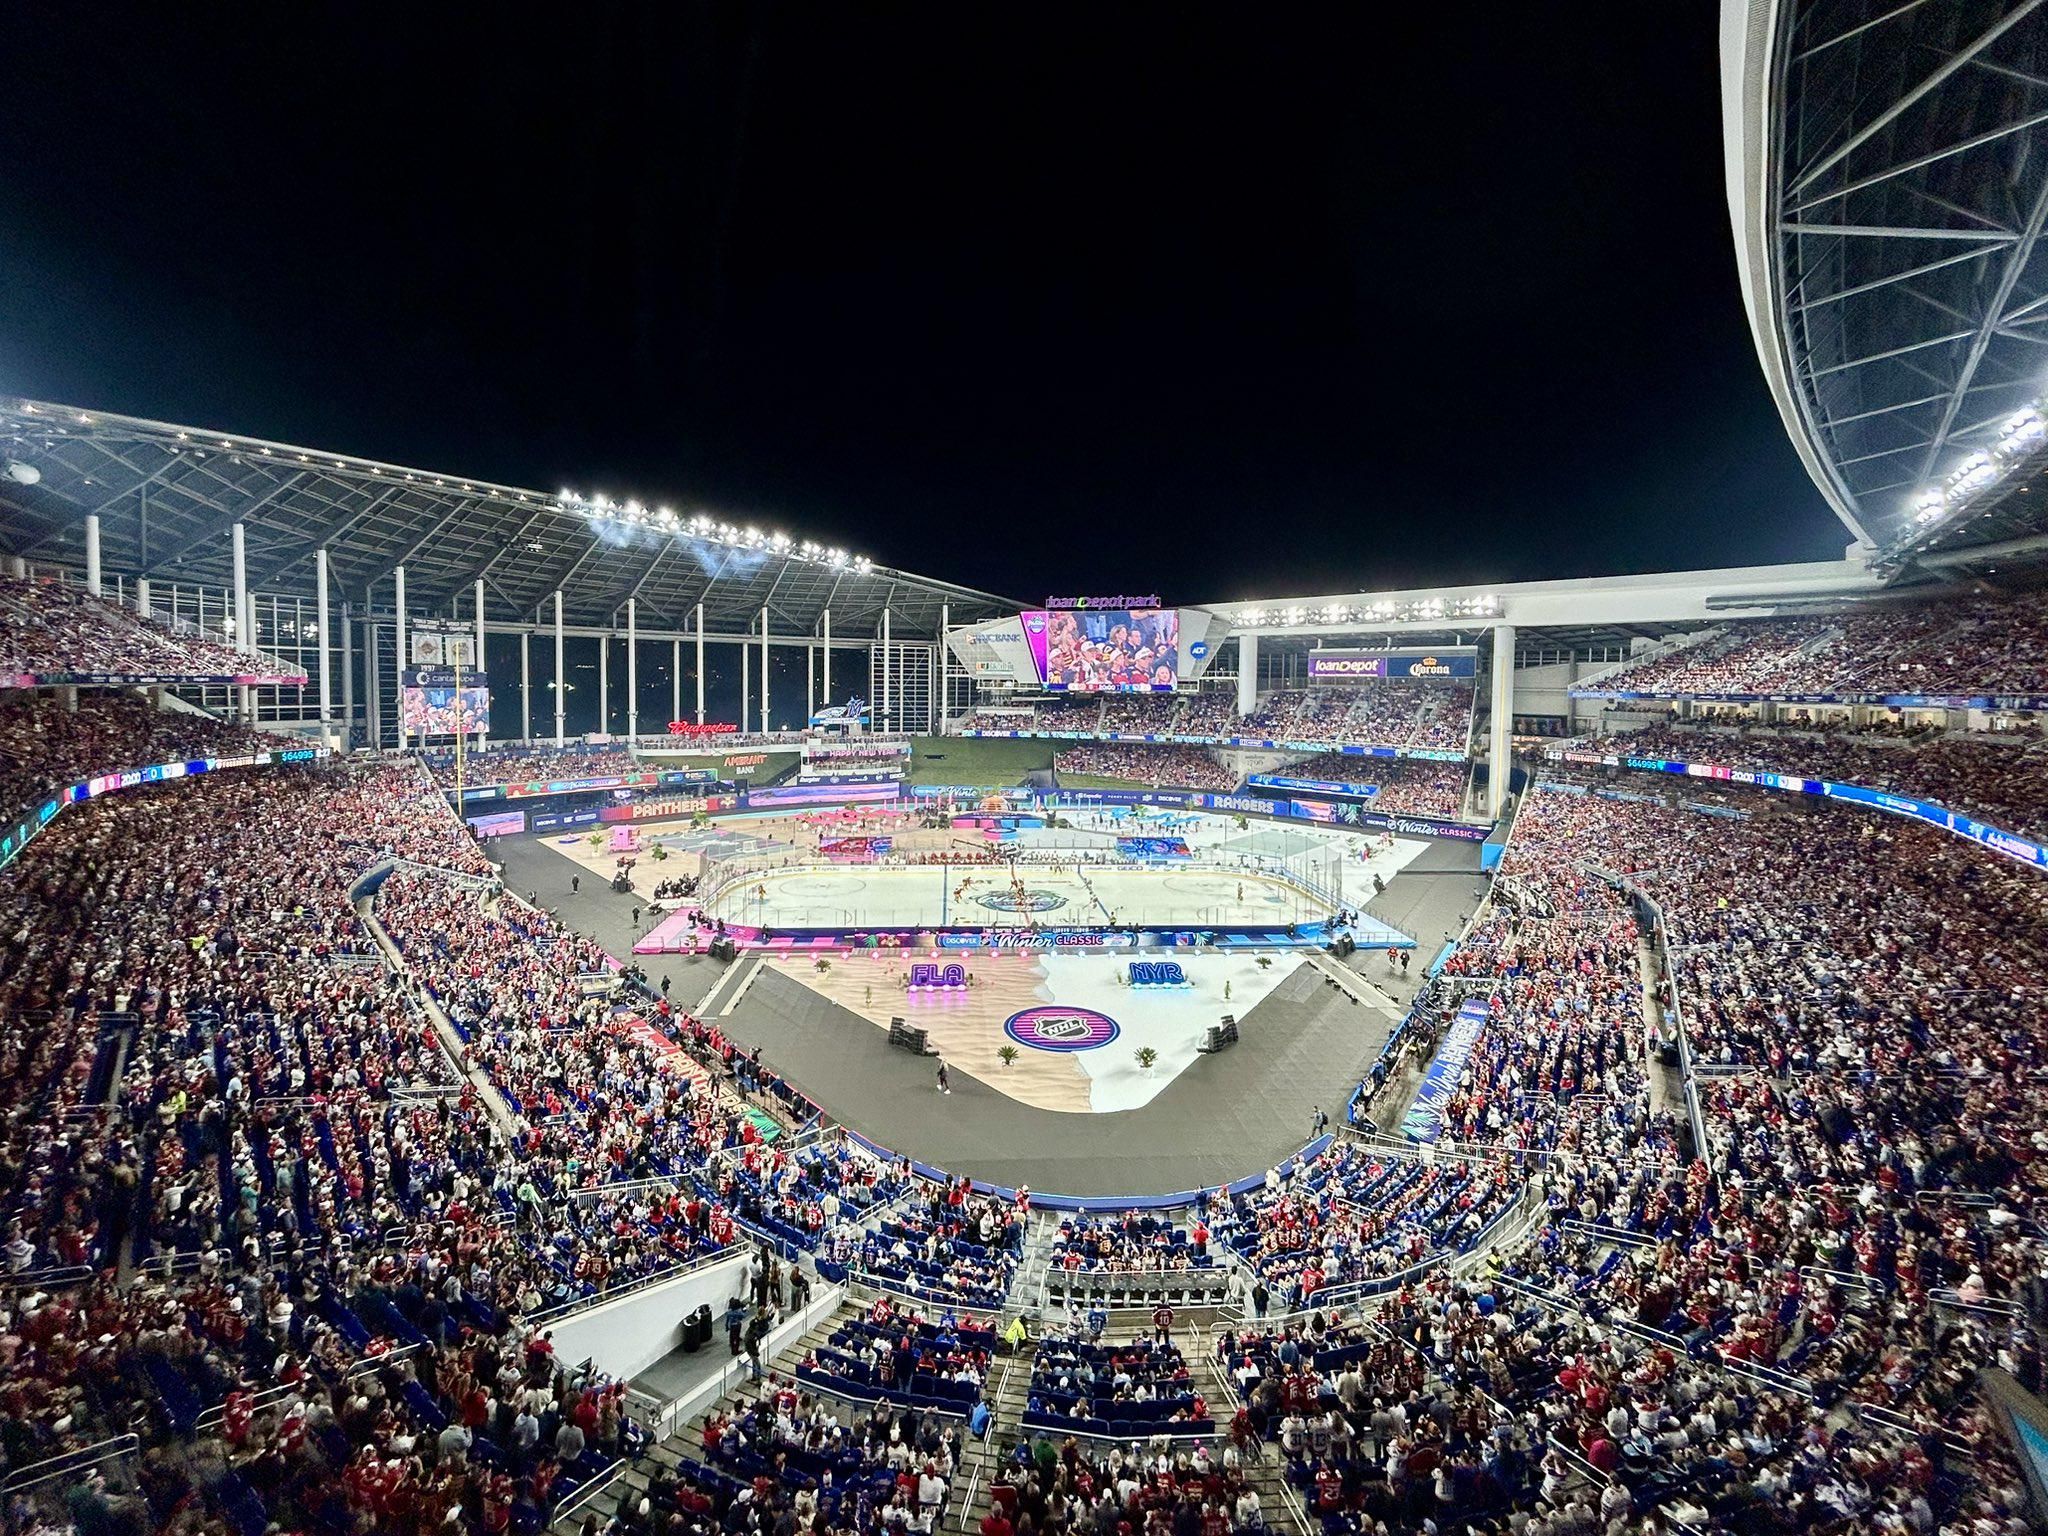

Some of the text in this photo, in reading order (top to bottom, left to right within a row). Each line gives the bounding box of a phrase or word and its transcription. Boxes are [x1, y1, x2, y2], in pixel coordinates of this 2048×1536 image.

[1047, 595, 1158, 608] loanDepot park
[1191, 646, 1206, 655] ADT
[1315, 660, 1378, 673] loanDepot
[1409, 663, 1450, 677] Corona
[432, 673, 475, 682] cantalupe
[667, 721, 738, 735] Budweiser
[830, 749, 856, 757] HAPPY
[858, 749, 876, 757] NEW
[736, 766, 756, 775] BANK
[946, 785, 980, 797] Winte
[632, 799, 708, 818] PANTHERS
[1214, 796, 1275, 814] RANGERS
[1397, 819, 1439, 836] Winter
[1439, 828, 1473, 838] CLASSIC
[945, 933, 1104, 947] DISCOVER Winter CLASSIC
[913, 964, 966, 985] FLA
[1130, 962, 1183, 981] NYR
[1047, 1020, 1079, 1037] NHL
[1438, 1017, 1481, 1071] RANGERS
[1159, 1315, 1170, 1325] 10
